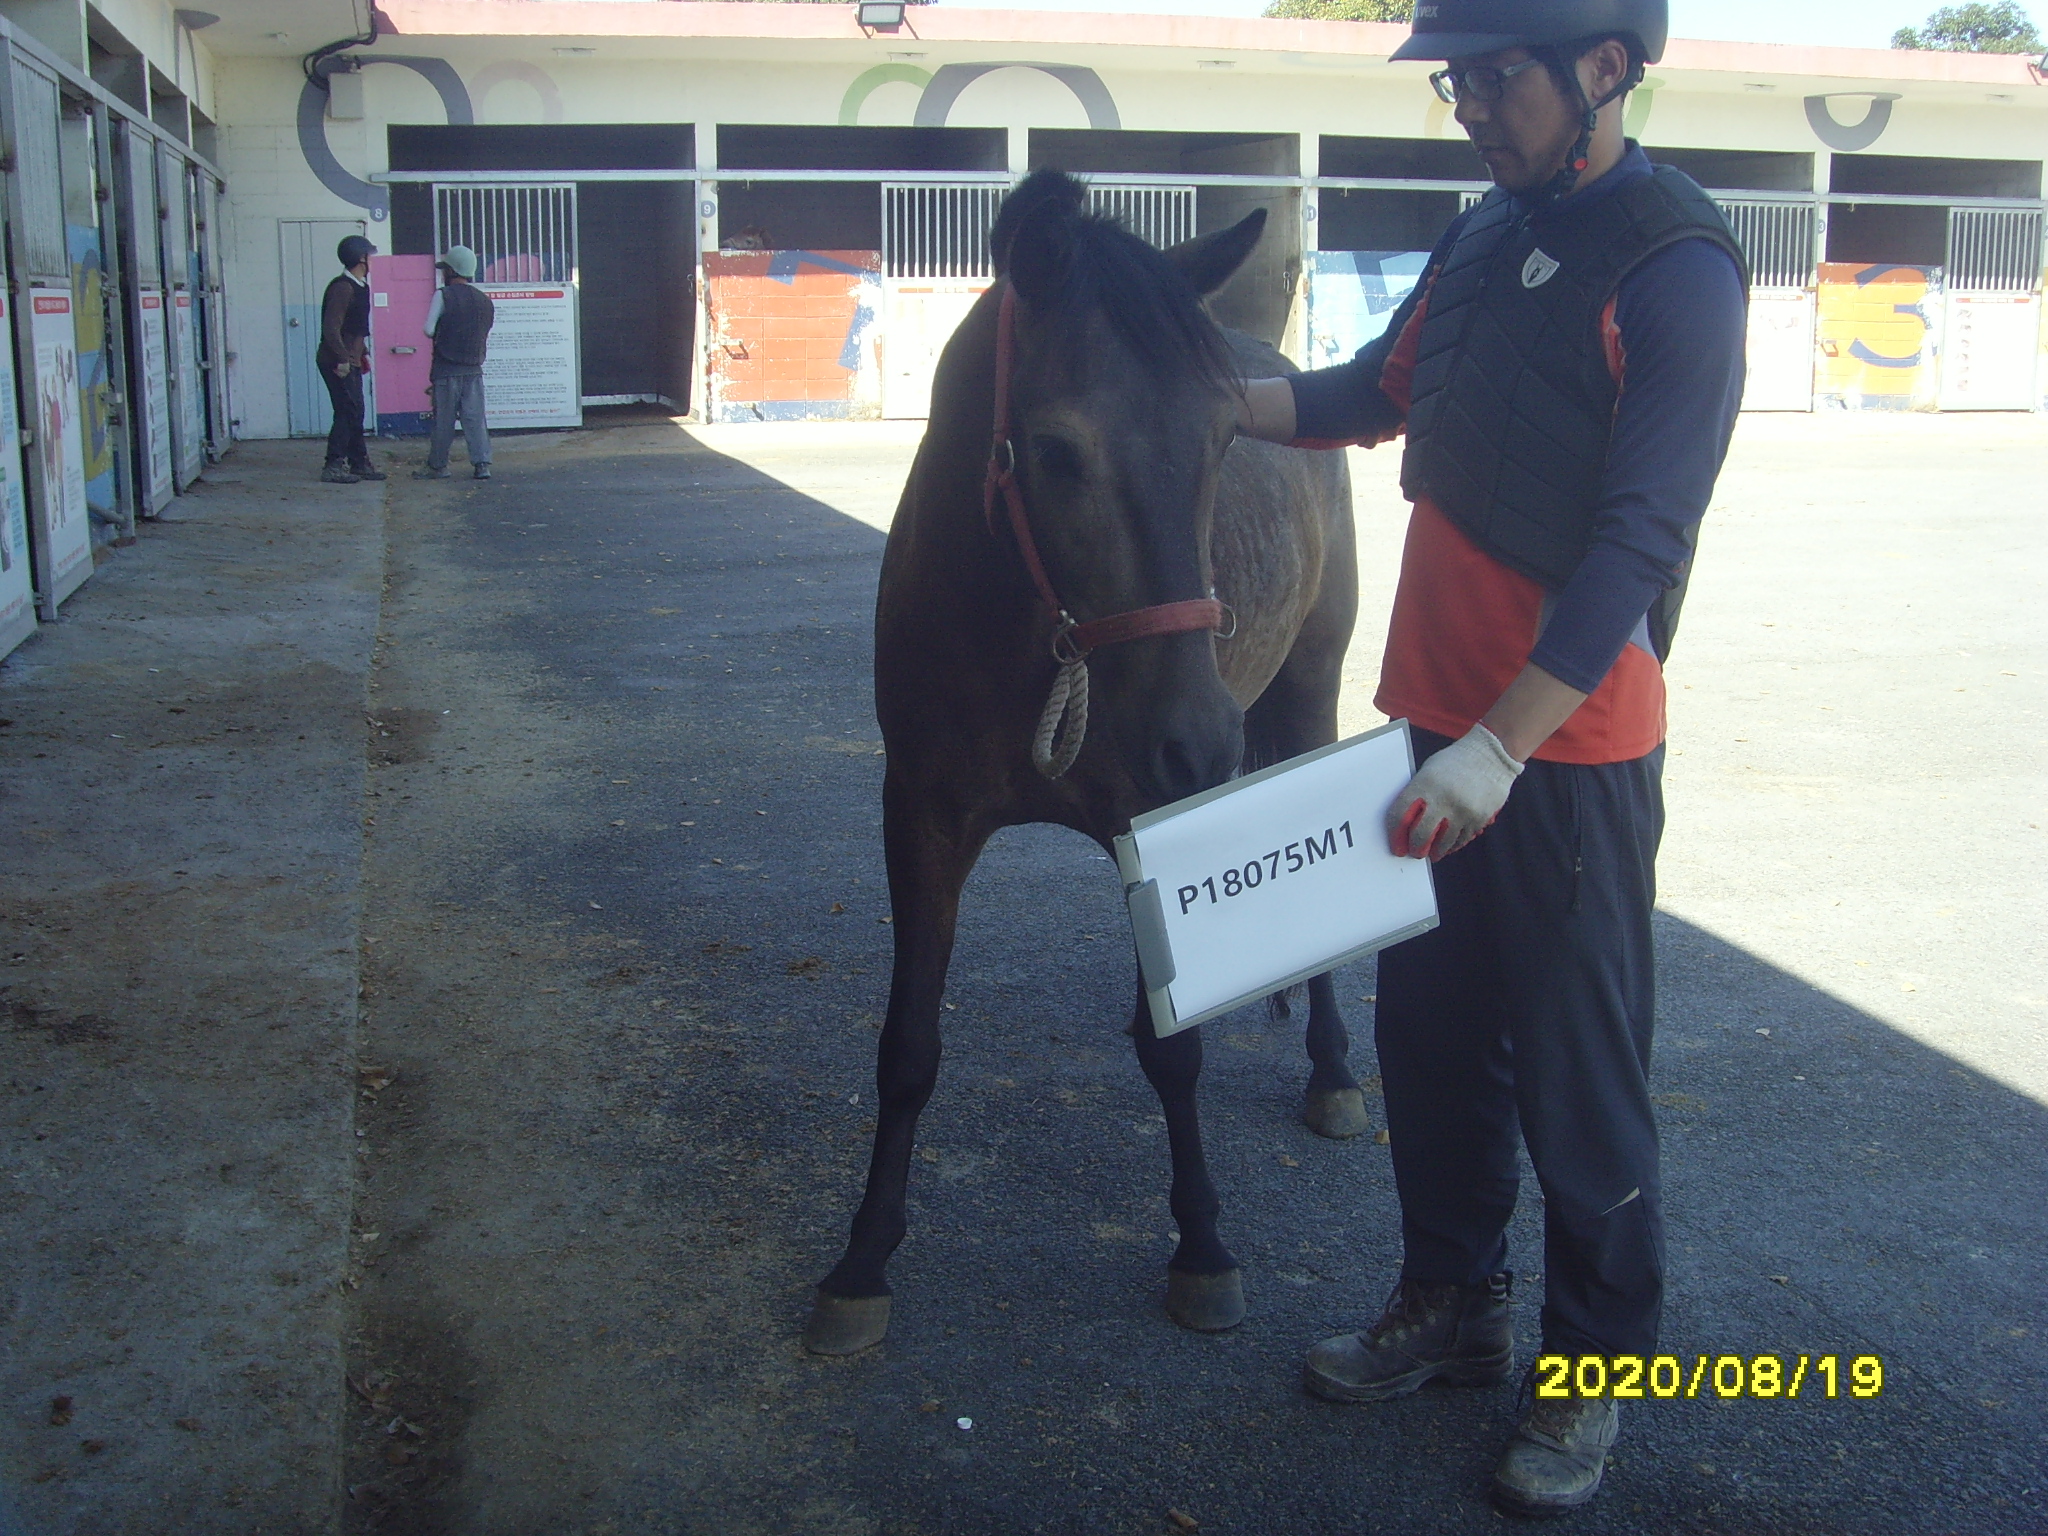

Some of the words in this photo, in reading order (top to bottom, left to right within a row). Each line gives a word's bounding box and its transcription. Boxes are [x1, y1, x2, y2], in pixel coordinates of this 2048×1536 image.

[374, 207, 383, 219] 8
[703, 204, 711, 215] 9
[1177, 820, 1354, 915] P18075M1
